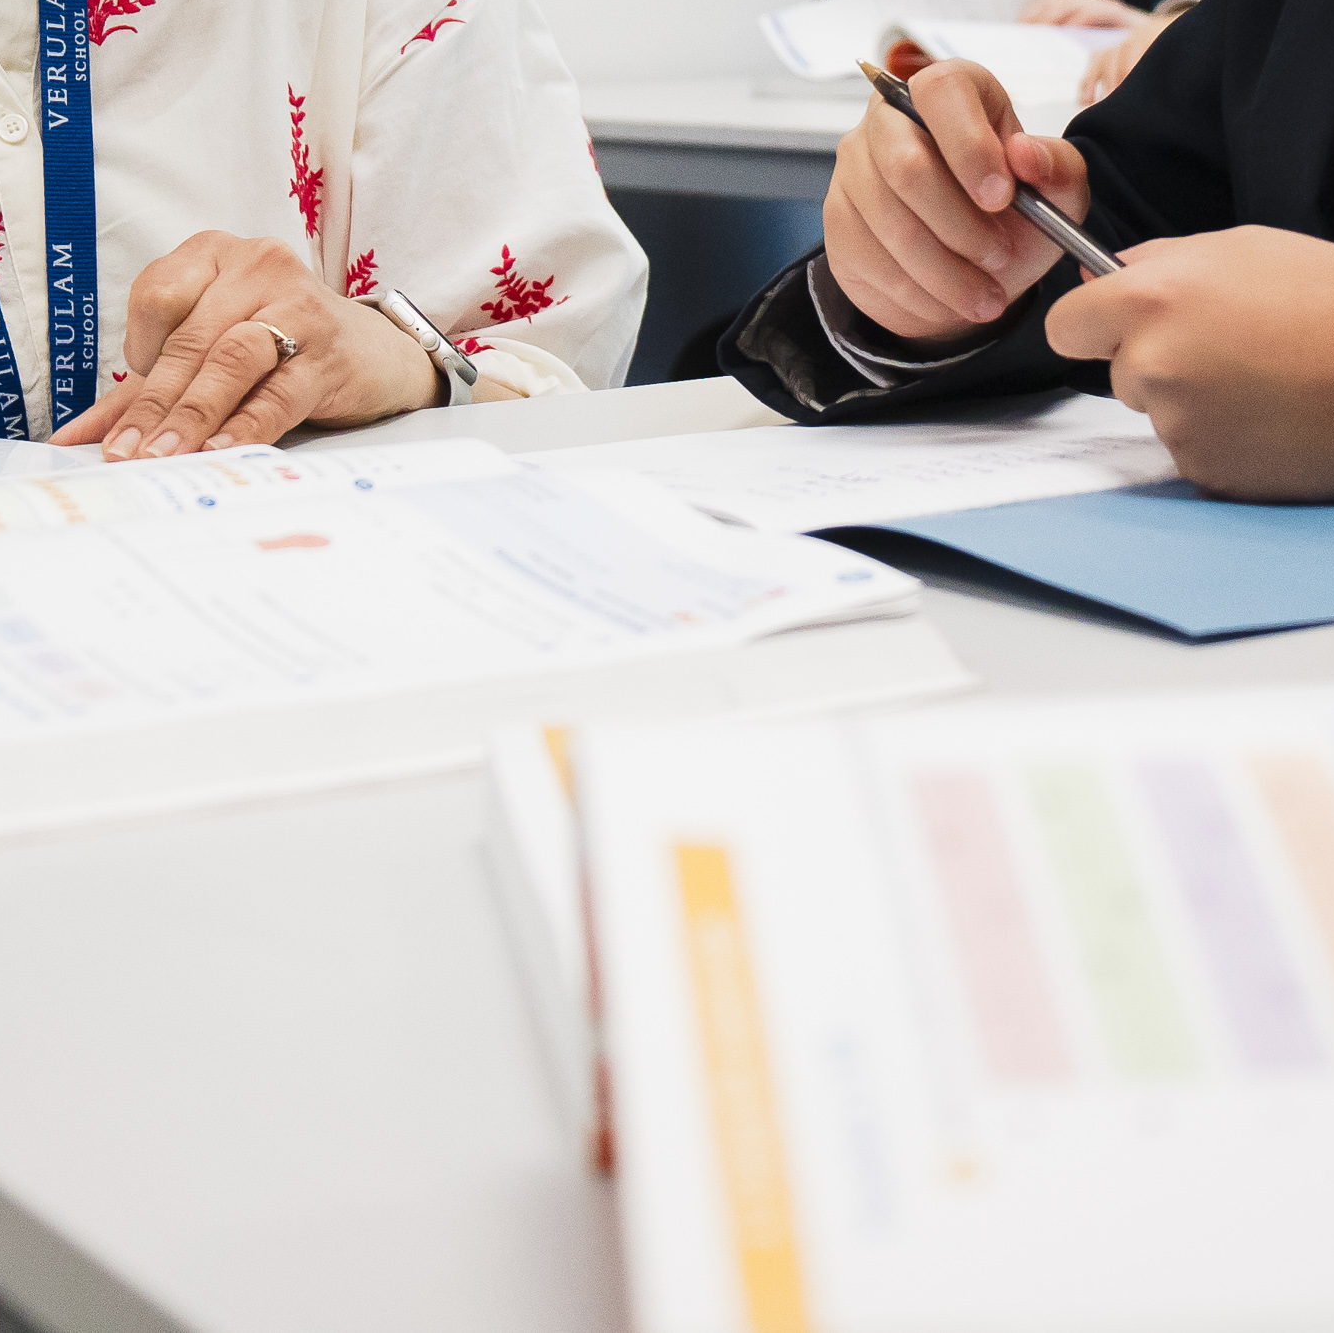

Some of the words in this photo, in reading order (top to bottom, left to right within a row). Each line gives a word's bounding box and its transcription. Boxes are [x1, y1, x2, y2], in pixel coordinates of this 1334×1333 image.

[74, 8, 87, 82] SCHOOL
[52, 242, 75, 423] VERULAM
[83, 292, 95, 370] SCHOOL
